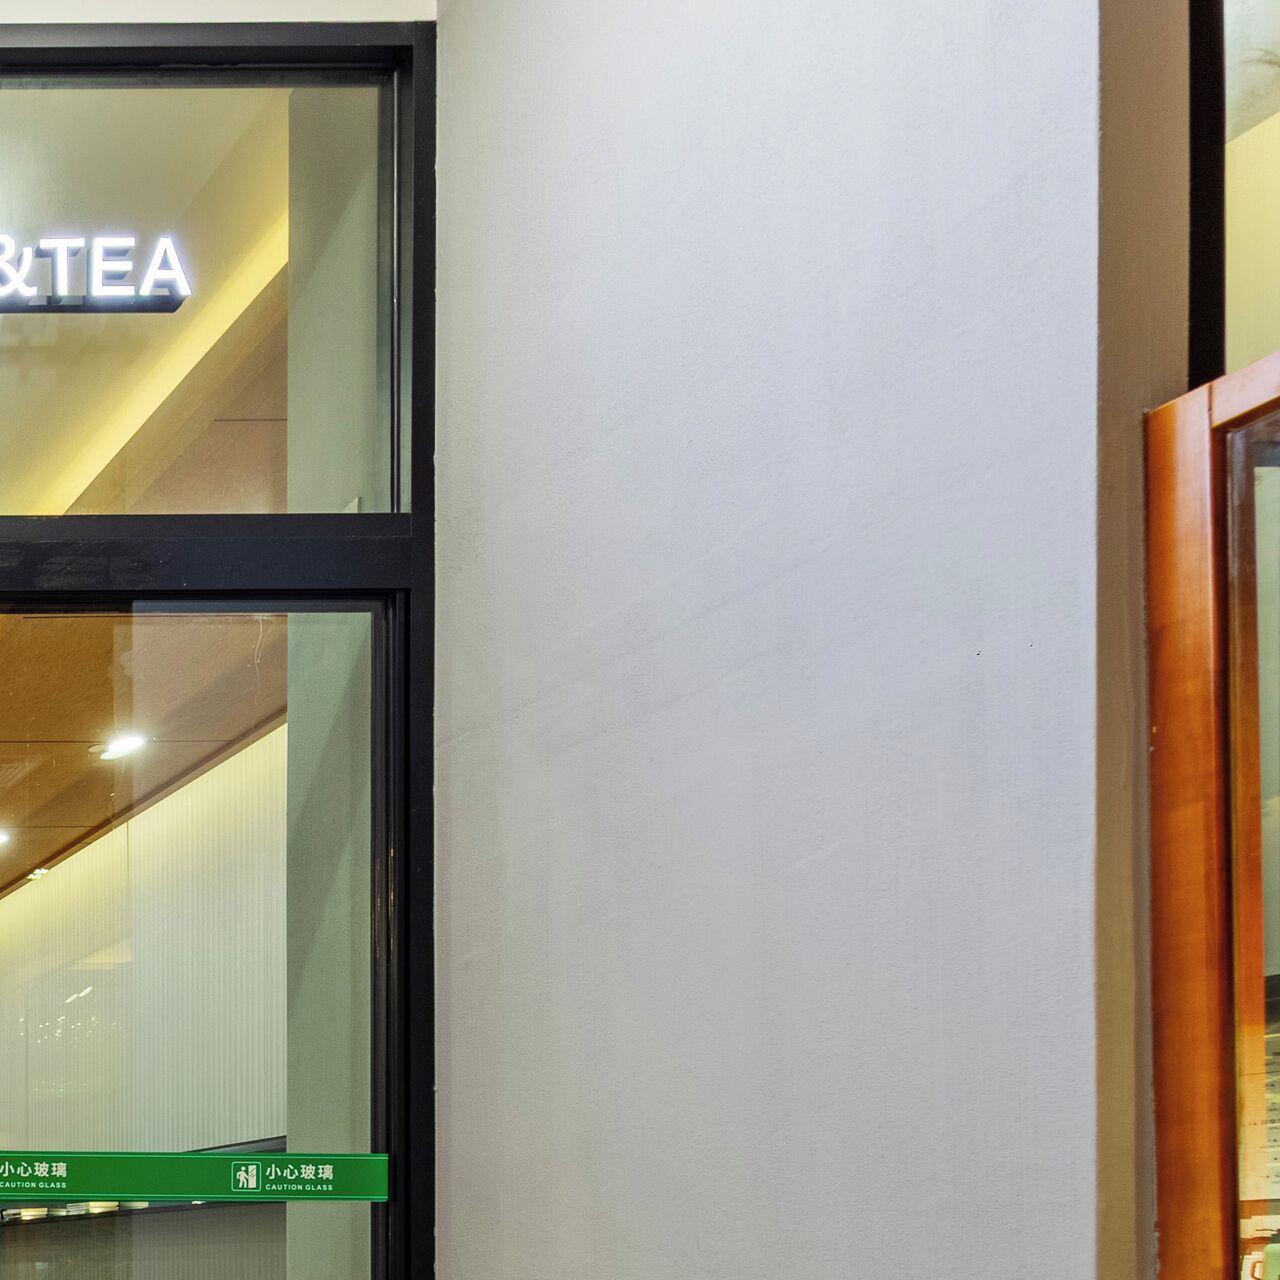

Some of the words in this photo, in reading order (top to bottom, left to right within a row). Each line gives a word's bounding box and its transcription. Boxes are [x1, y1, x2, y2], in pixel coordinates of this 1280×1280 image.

[0, 1161, 67, 1178] 小心玻璃
[266, 1164, 334, 1181] 小心玻璃
